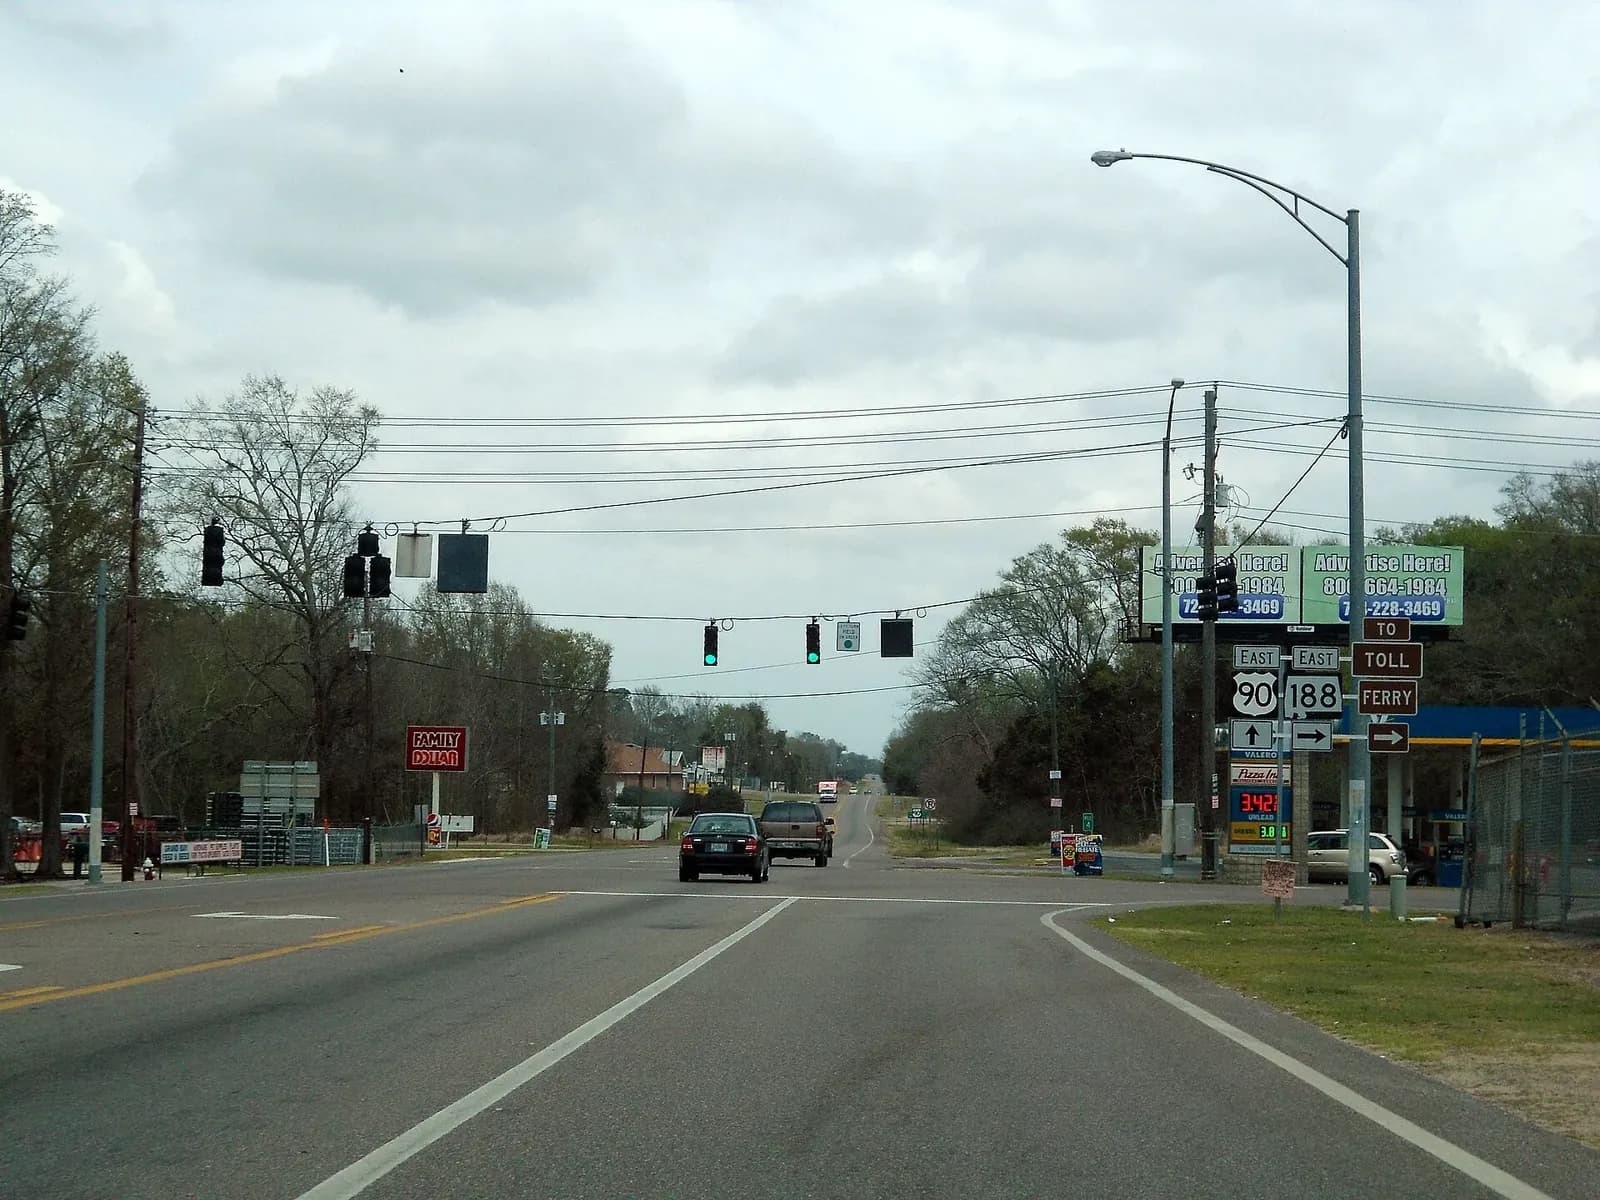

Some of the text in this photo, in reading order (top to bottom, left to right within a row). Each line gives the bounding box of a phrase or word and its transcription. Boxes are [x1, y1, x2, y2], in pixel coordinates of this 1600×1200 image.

[1240, 553, 1289, 571] Here!
[1314, 553, 1451, 572] Advtise Here!
[1323, 577, 1447, 596] 80664-1984
[1343, 600, 1441, 616] 7-228-3469
[1377, 622, 1396, 636] TO
[1241, 649, 1274, 665] EAST
[1300, 649, 1333, 666] EAST
[1365, 652, 1410, 668] TOLL
[1239, 682, 1273, 707] 90
[1291, 683, 1336, 708] 188
[1363, 690, 1412, 705] FERRY
[413, 732, 461, 748] FAMILY
[412, 750, 459, 766] DOLLAR
[1245, 751, 1277, 759] VALERO
[1238, 768, 1279, 779] Pizza In
